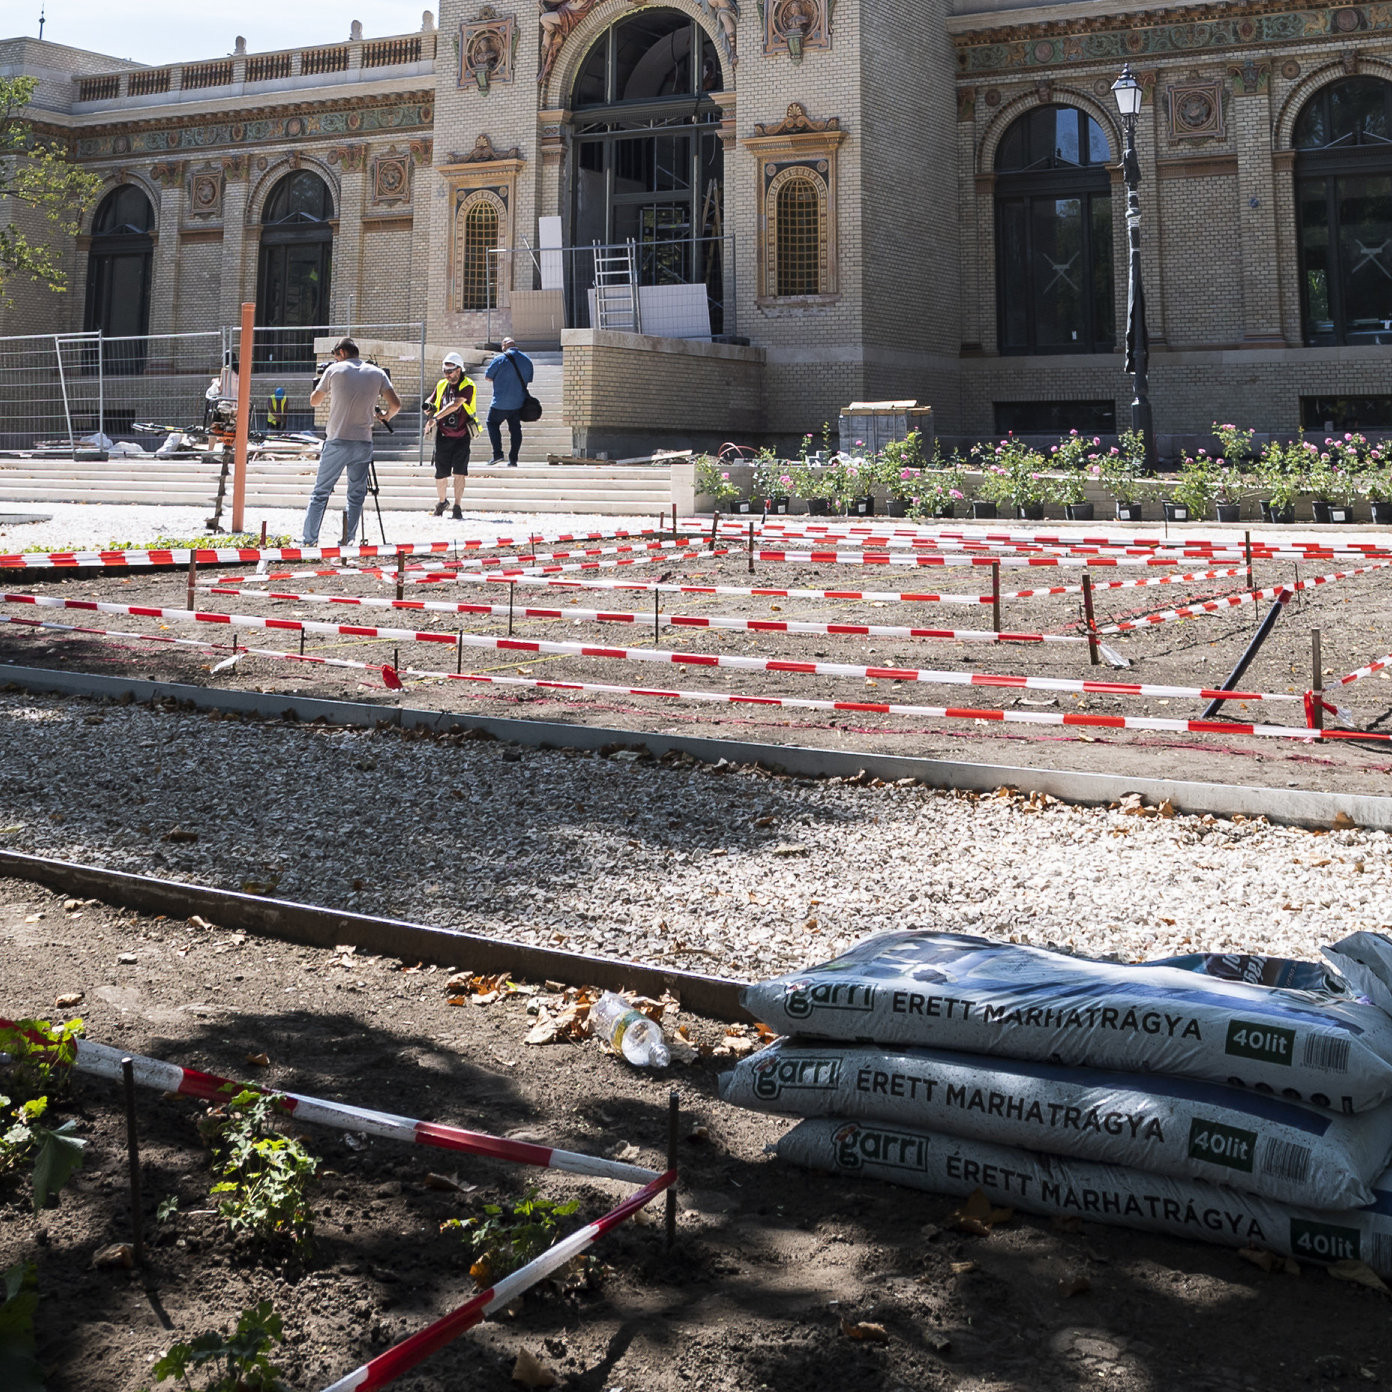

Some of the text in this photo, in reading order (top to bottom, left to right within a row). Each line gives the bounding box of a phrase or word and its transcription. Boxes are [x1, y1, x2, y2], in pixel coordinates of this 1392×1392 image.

[787, 982, 873, 1016] garri
[982, 1004, 1203, 1041] MARHATRÁGYA
[1232, 1028, 1289, 1055] 40lit
[756, 1056, 1165, 1143] garri ÉRETT MARHATRÁGYA
[1194, 1129, 1250, 1161] 40lit
[836, 1125, 1266, 1242] garri ÉRETT MARHATRÁGYA
[1296, 1231, 1355, 1260] 40lit
